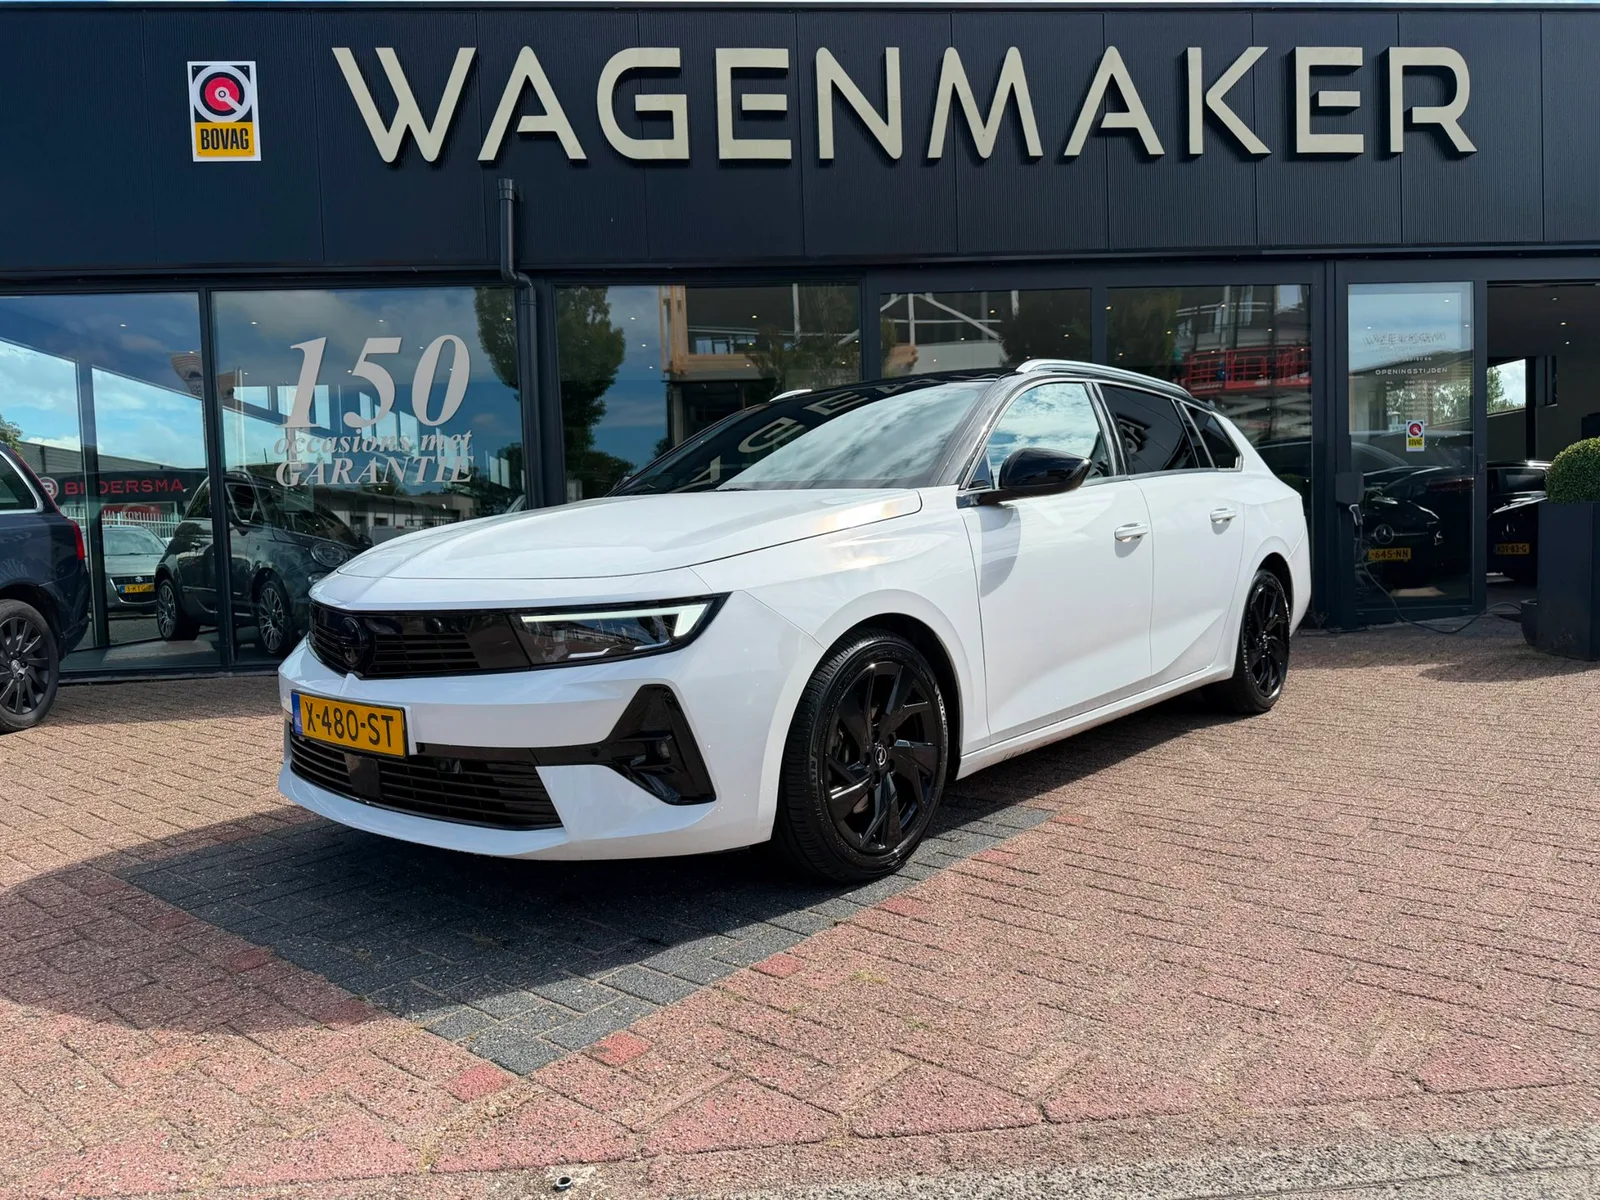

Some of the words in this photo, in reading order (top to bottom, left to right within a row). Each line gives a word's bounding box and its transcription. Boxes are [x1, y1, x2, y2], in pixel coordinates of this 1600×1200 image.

[331, 45, 1478, 162] WAGENMAKER
[200, 127, 249, 150] BOVAG
[275, 334, 471, 429] 150
[1375, 367, 1448, 376] OPENINGSTIJDEN
[273, 428, 410, 455] occasions
[420, 429, 473, 451] met
[275, 455, 475, 488] GARANTIE
[304, 701, 395, 748] X-480-ST
